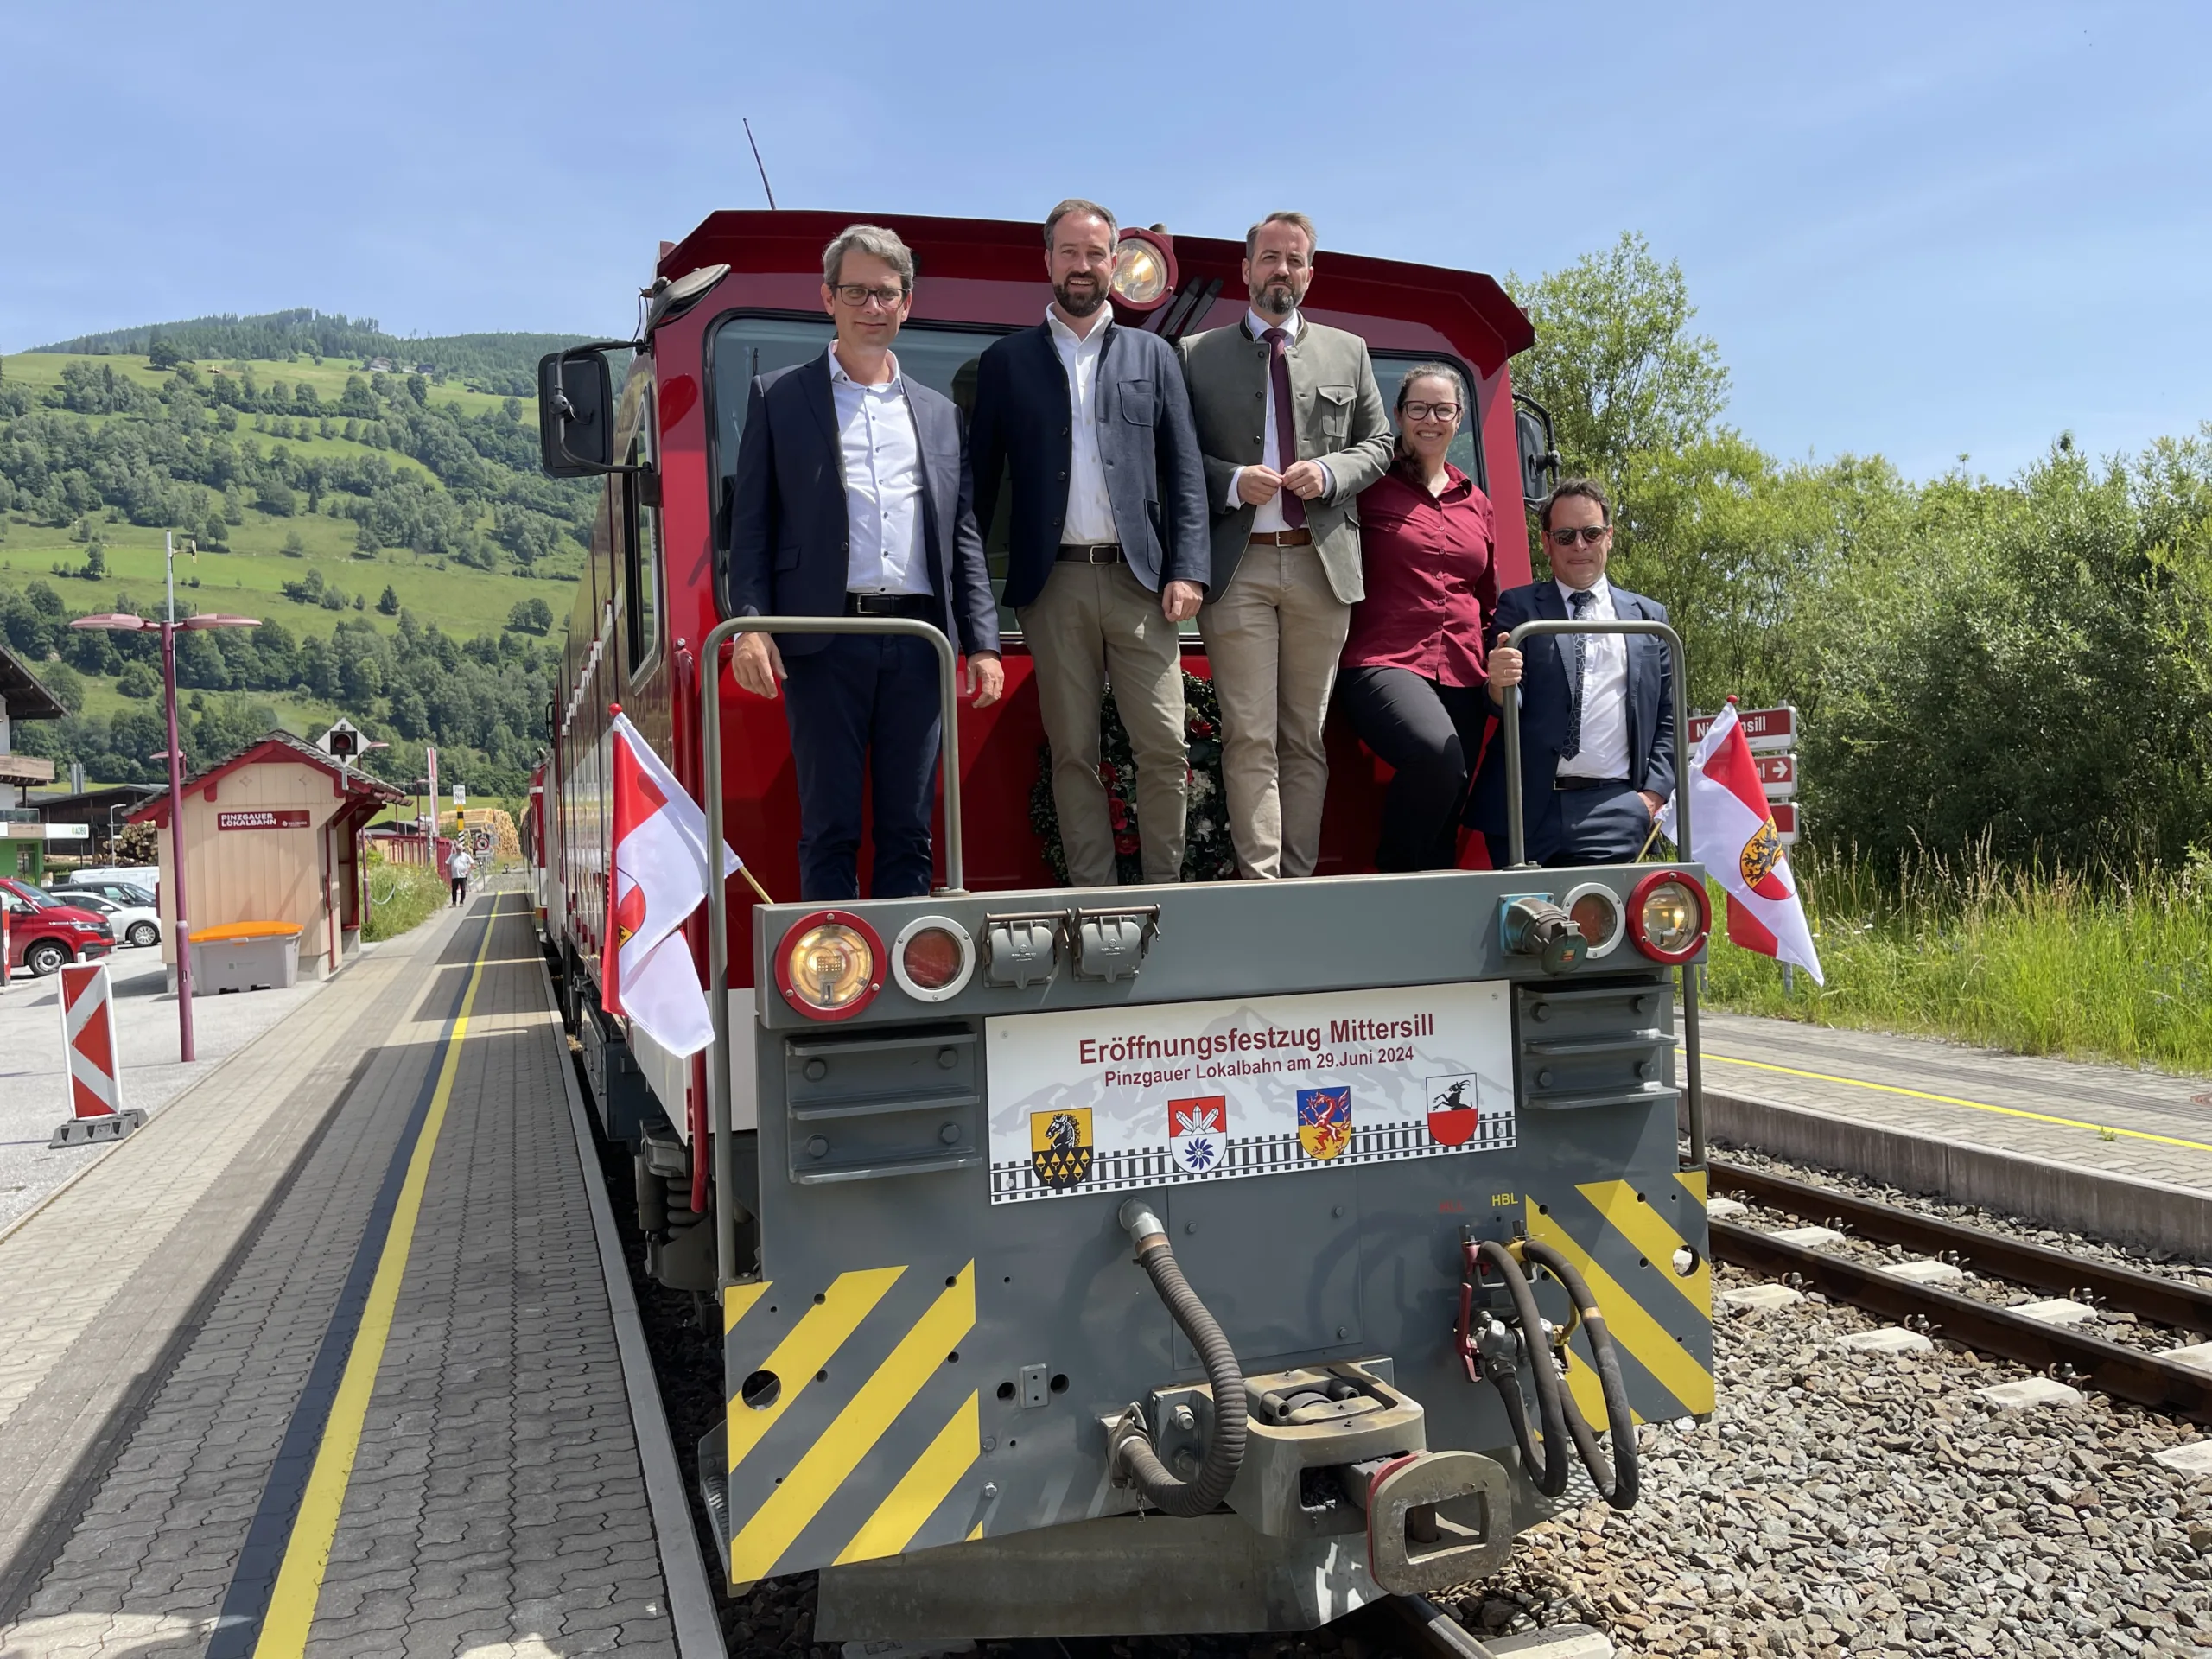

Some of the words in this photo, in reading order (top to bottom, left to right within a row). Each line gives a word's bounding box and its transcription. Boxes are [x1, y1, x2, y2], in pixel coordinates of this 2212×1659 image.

[221, 813, 273, 822] PINZGAUER
[1080, 1027, 1321, 1064] Eröffnungsfestzug
[1330, 1014, 1433, 1044] Mittersill
[1105, 1068, 1191, 1088] Pinzgauer
[1196, 1058, 1281, 1079] Lokalbahn
[1287, 1058, 1311, 1071] am
[1316, 1049, 1373, 1069] 29.Juni
[1377, 1046, 1414, 1064] 2024
[1491, 1192, 1518, 1207] HBL
